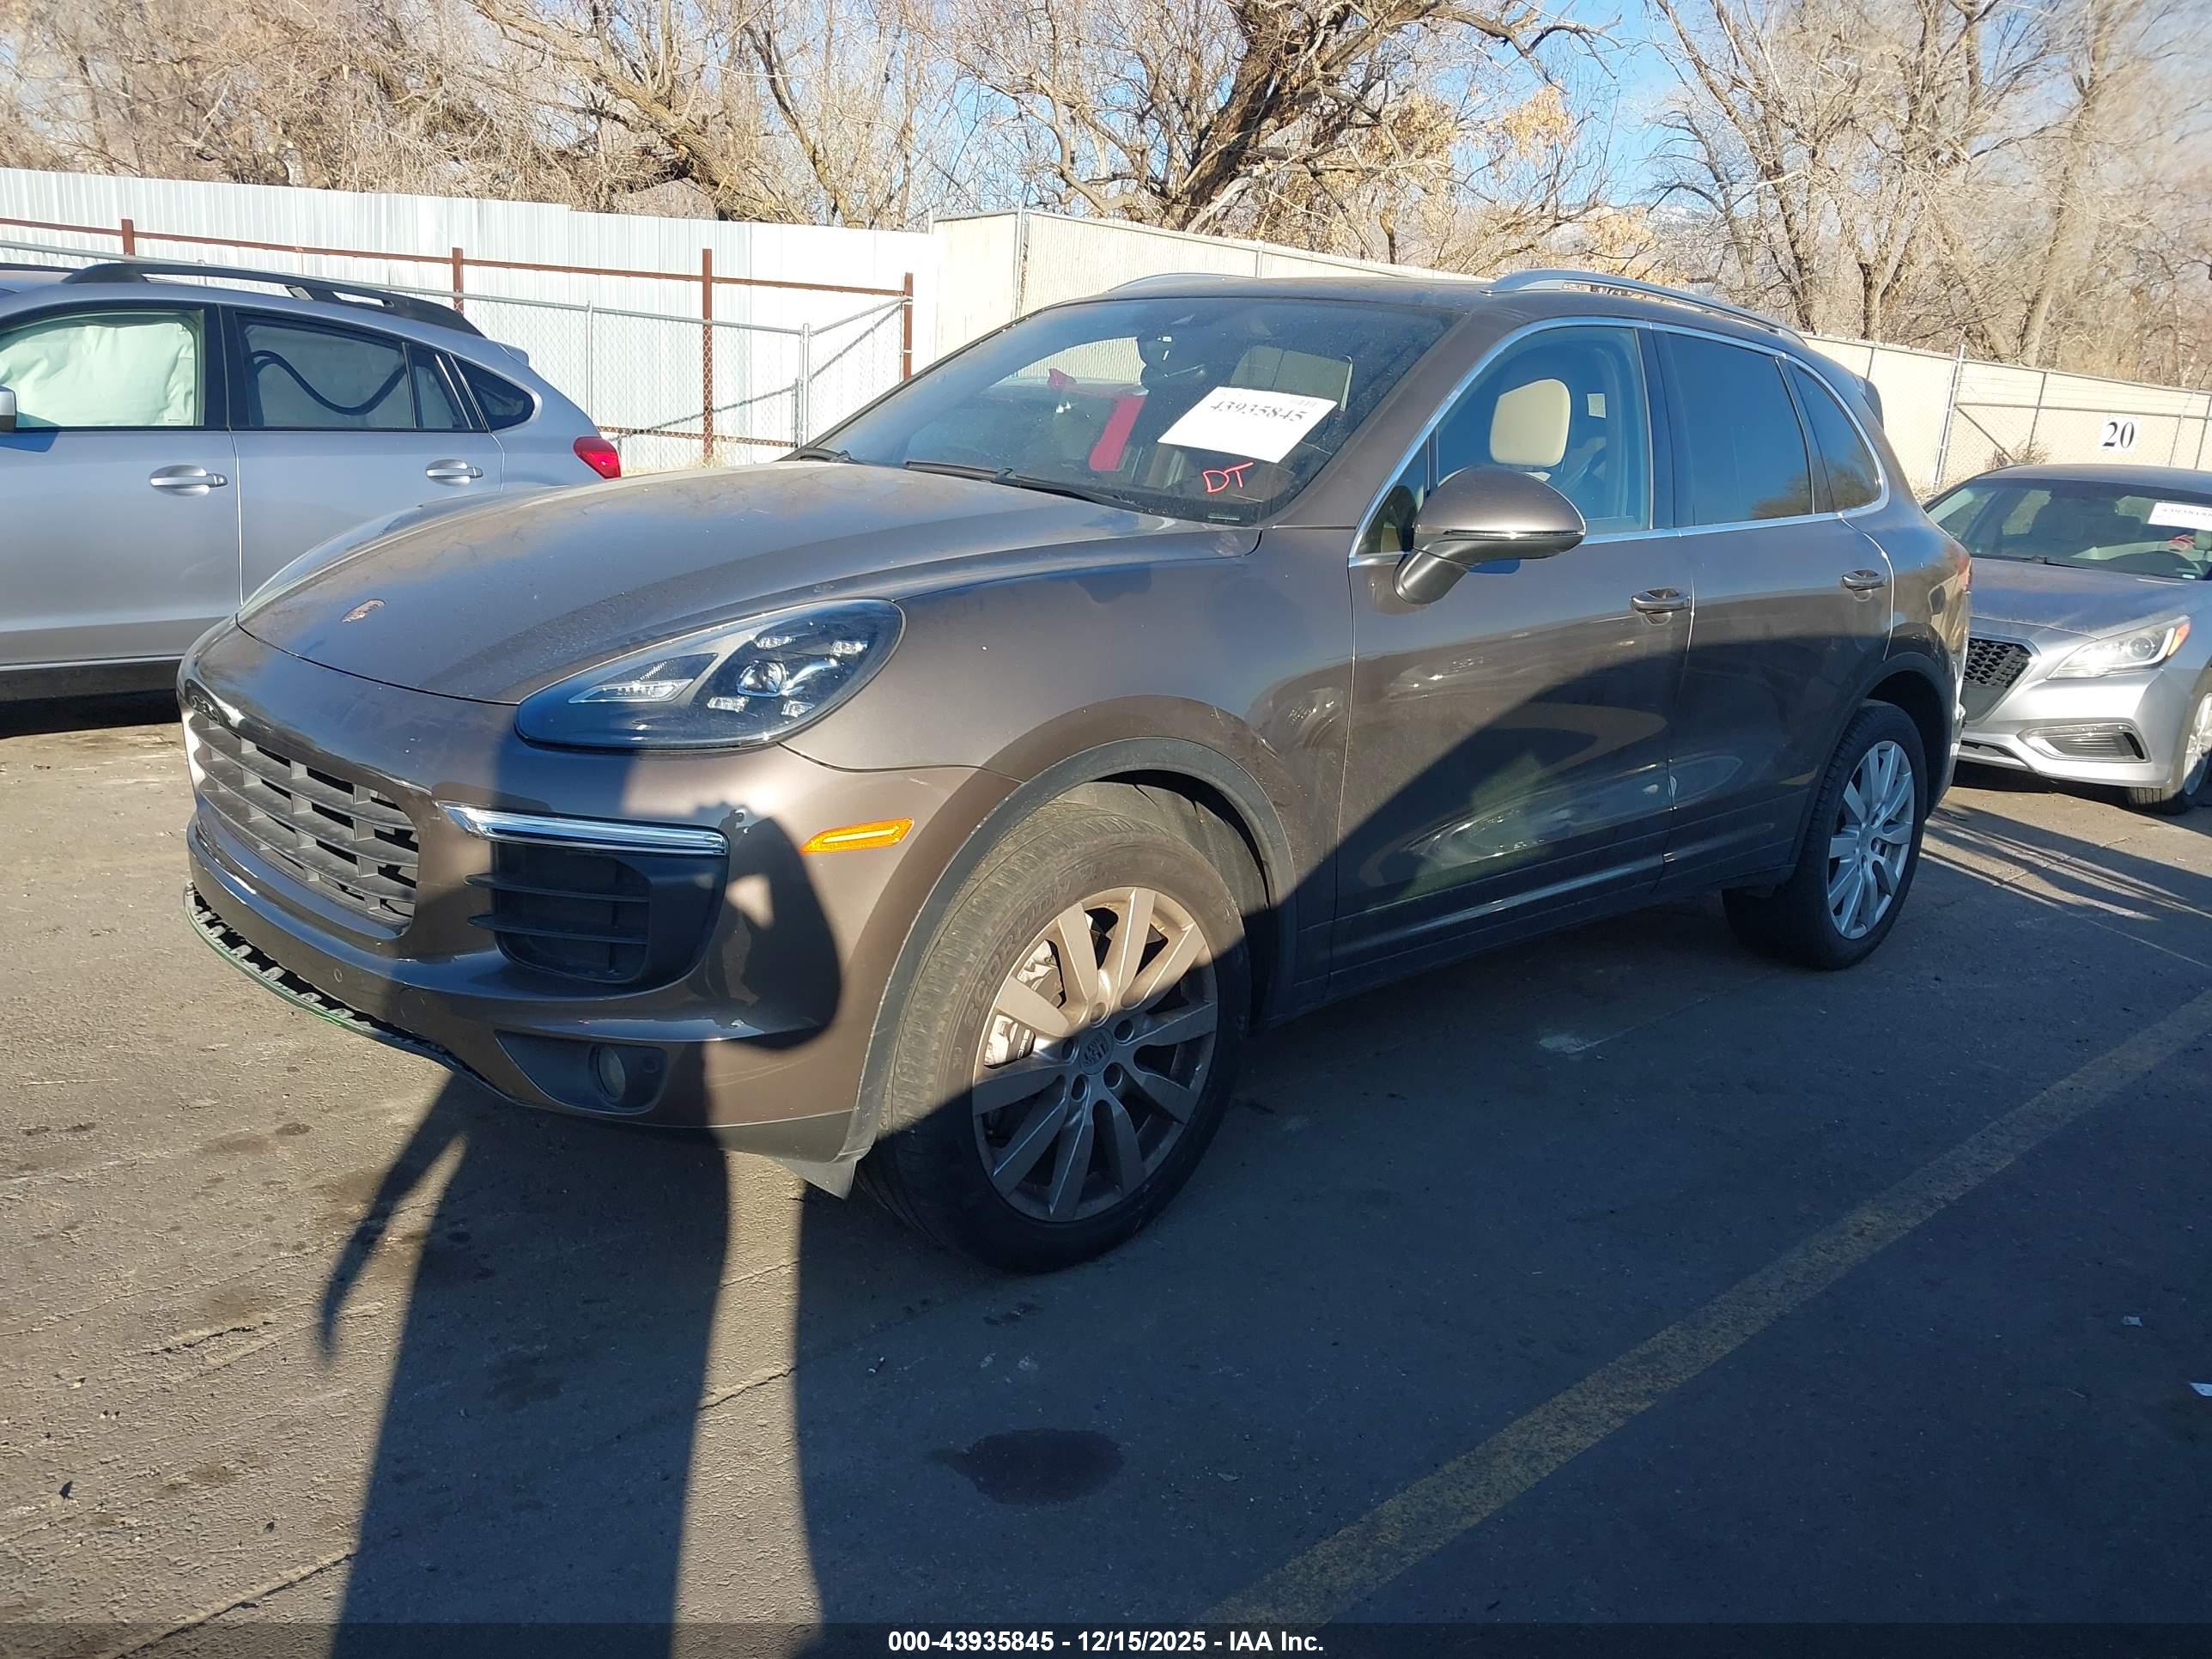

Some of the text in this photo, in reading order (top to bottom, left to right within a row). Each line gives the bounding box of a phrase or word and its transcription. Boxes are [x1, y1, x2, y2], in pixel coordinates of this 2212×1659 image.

[1210, 400, 1308, 422] 43935845
[2102, 421, 2136, 448] 20
[1202, 461, 1255, 494] DT
